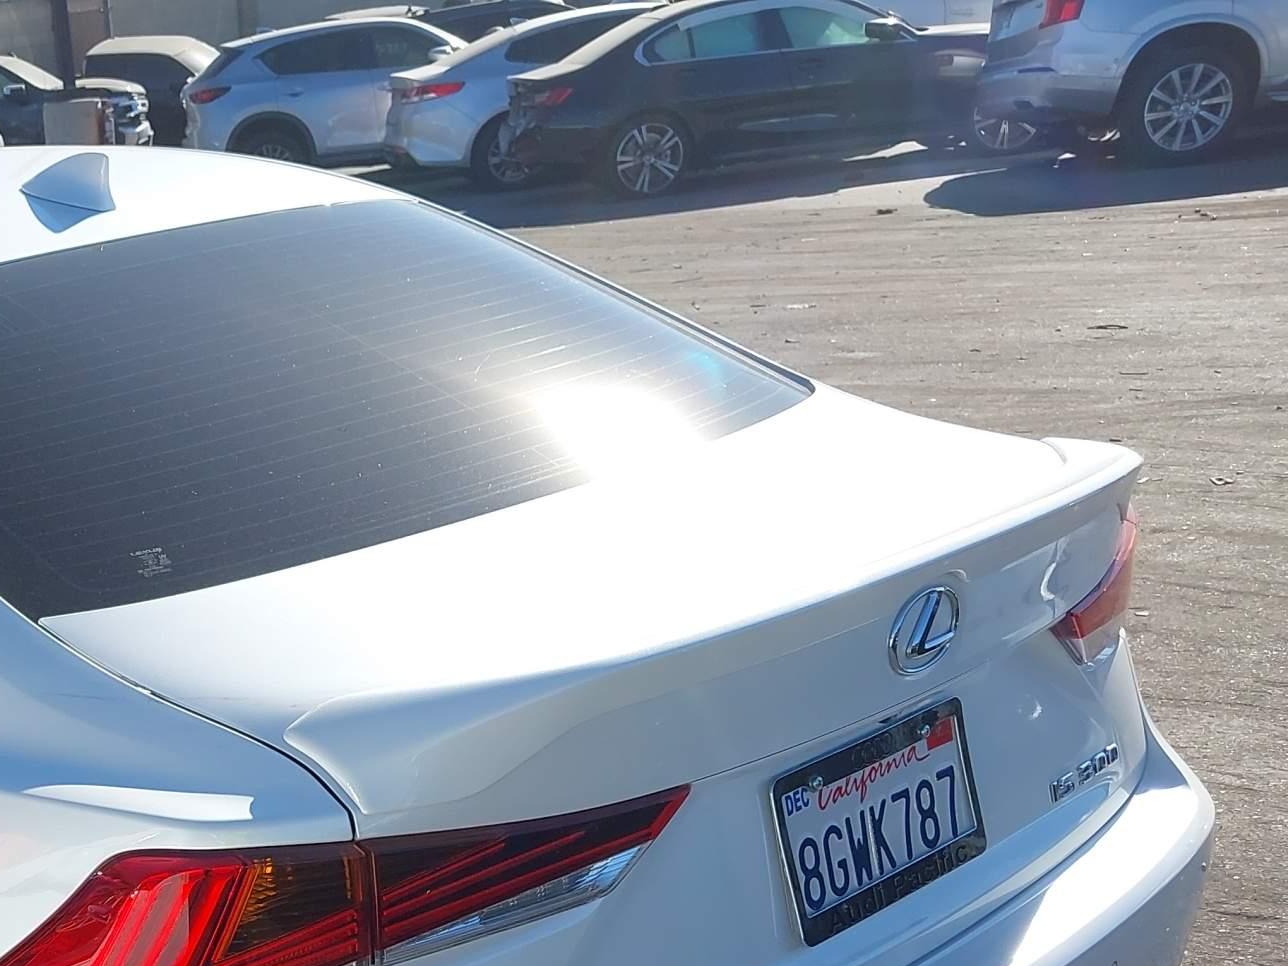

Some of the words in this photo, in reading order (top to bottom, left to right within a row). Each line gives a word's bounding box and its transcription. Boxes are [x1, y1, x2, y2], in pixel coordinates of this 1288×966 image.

[785, 788, 810, 817] DEC
[817, 744, 930, 811] California
[798, 764, 959, 911] 8GWK787
